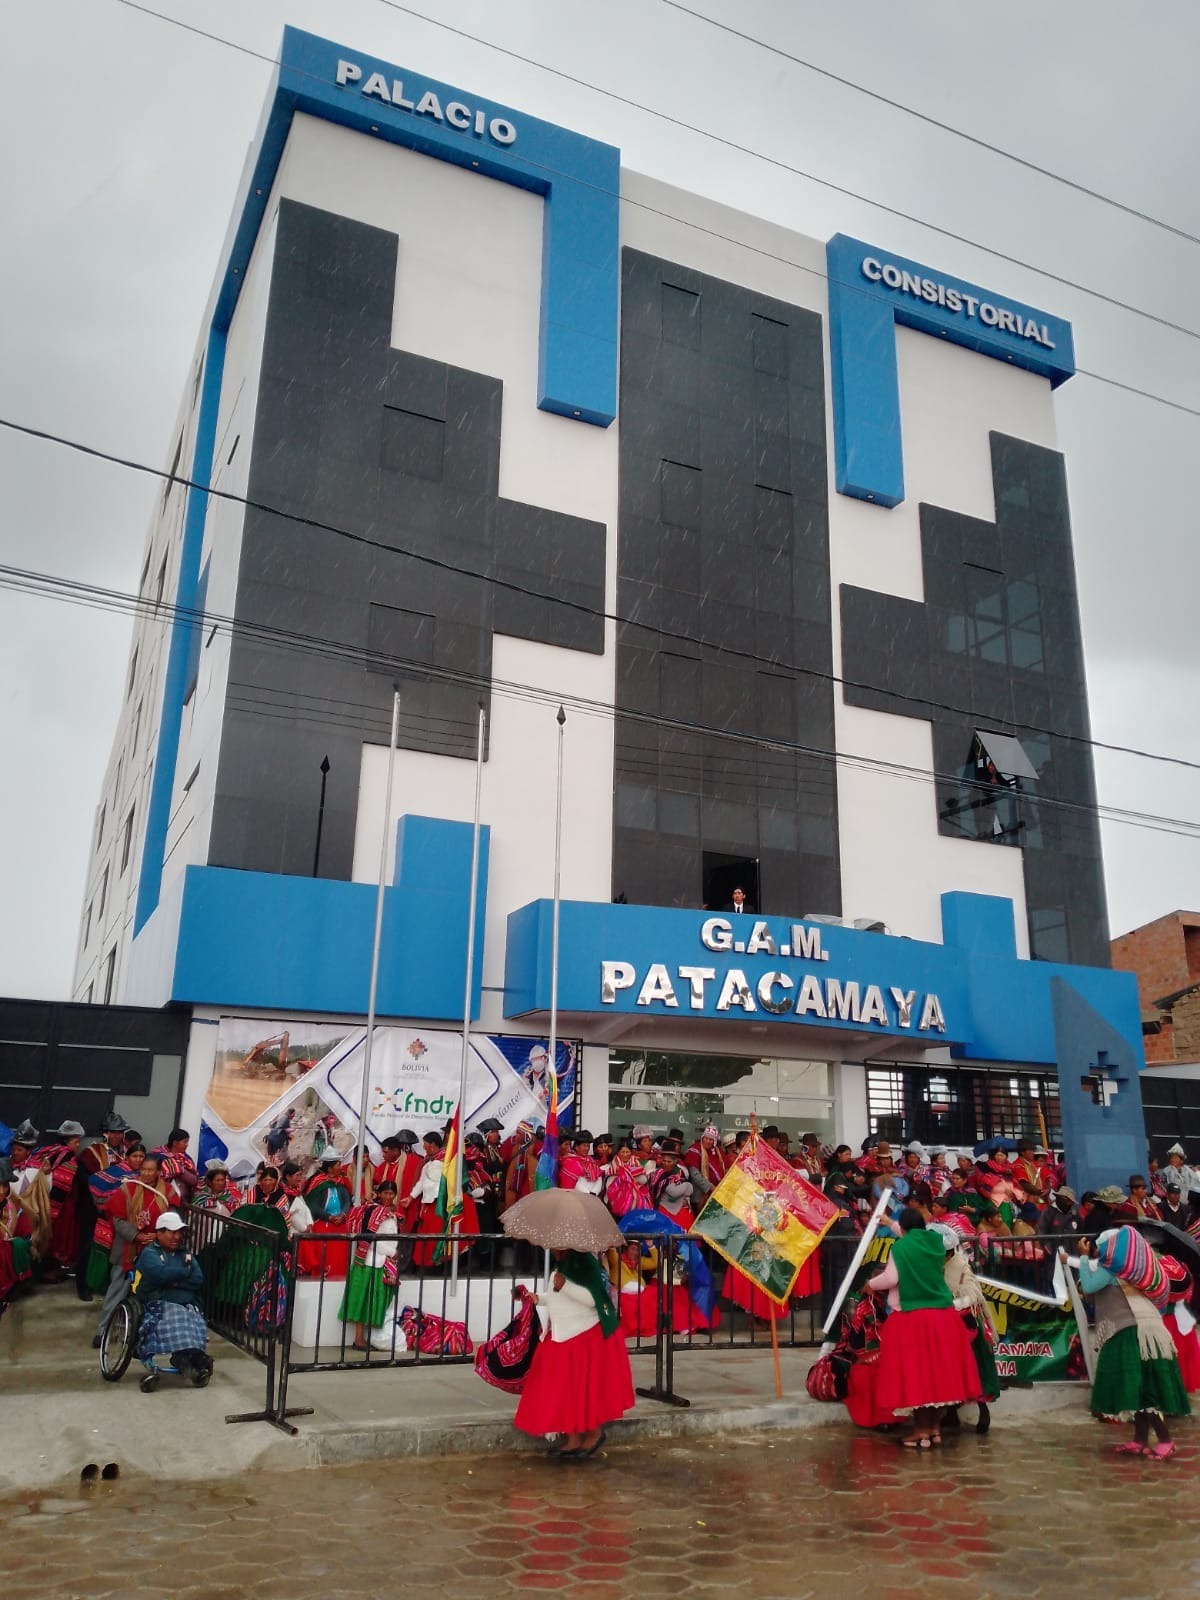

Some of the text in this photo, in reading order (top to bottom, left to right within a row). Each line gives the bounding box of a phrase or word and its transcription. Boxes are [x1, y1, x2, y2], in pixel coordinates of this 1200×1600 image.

[336, 58, 517, 145] PALACIO
[862, 257, 1056, 350] CONSISTORIAL
[700, 917, 830, 962] G.A.M.
[600, 960, 946, 1034] PATACAMAYA
[401, 1064, 430, 1073] BOLIVIA
[405, 1092, 454, 1115] fndr
